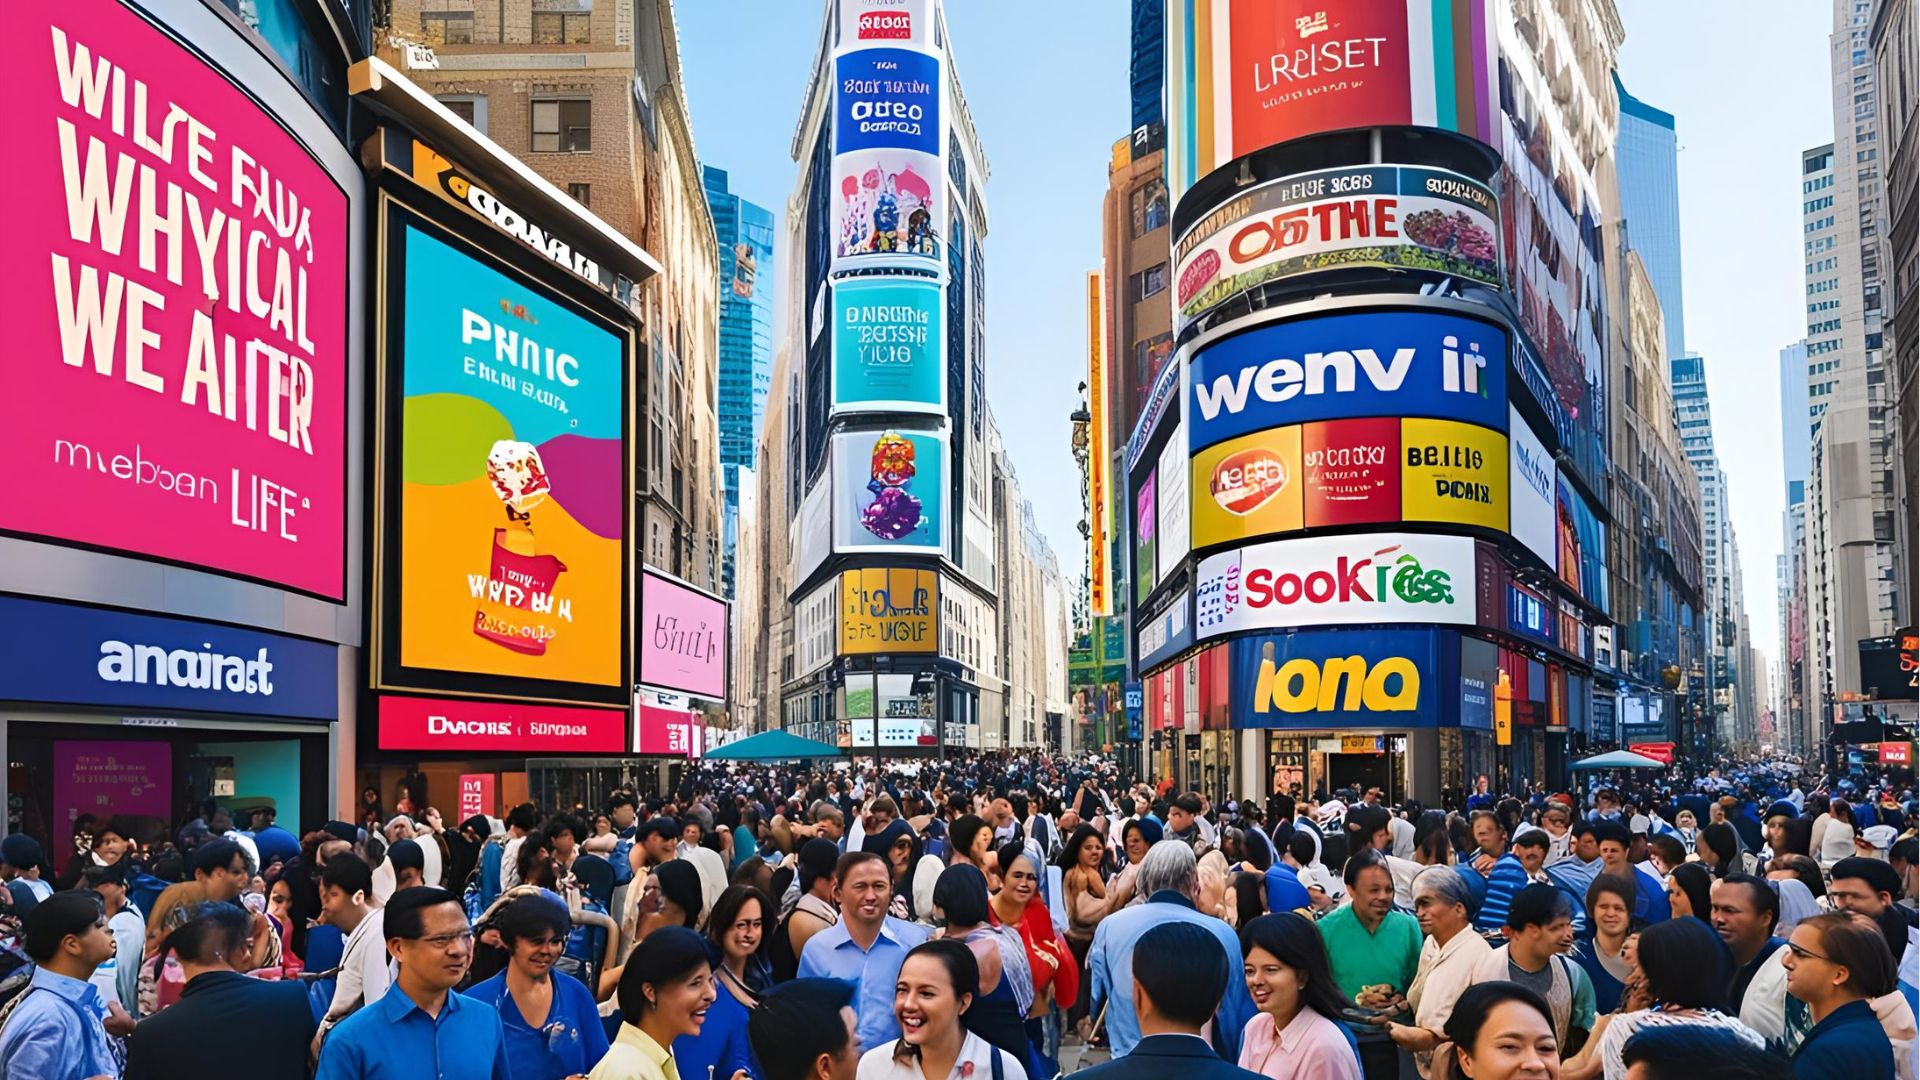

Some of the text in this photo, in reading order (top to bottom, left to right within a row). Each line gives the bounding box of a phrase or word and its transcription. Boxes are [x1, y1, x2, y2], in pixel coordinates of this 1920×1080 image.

[51, 252, 165, 394] WE
[1196, 346, 1416, 422] wenv
[1254, 641, 1420, 714] iona
